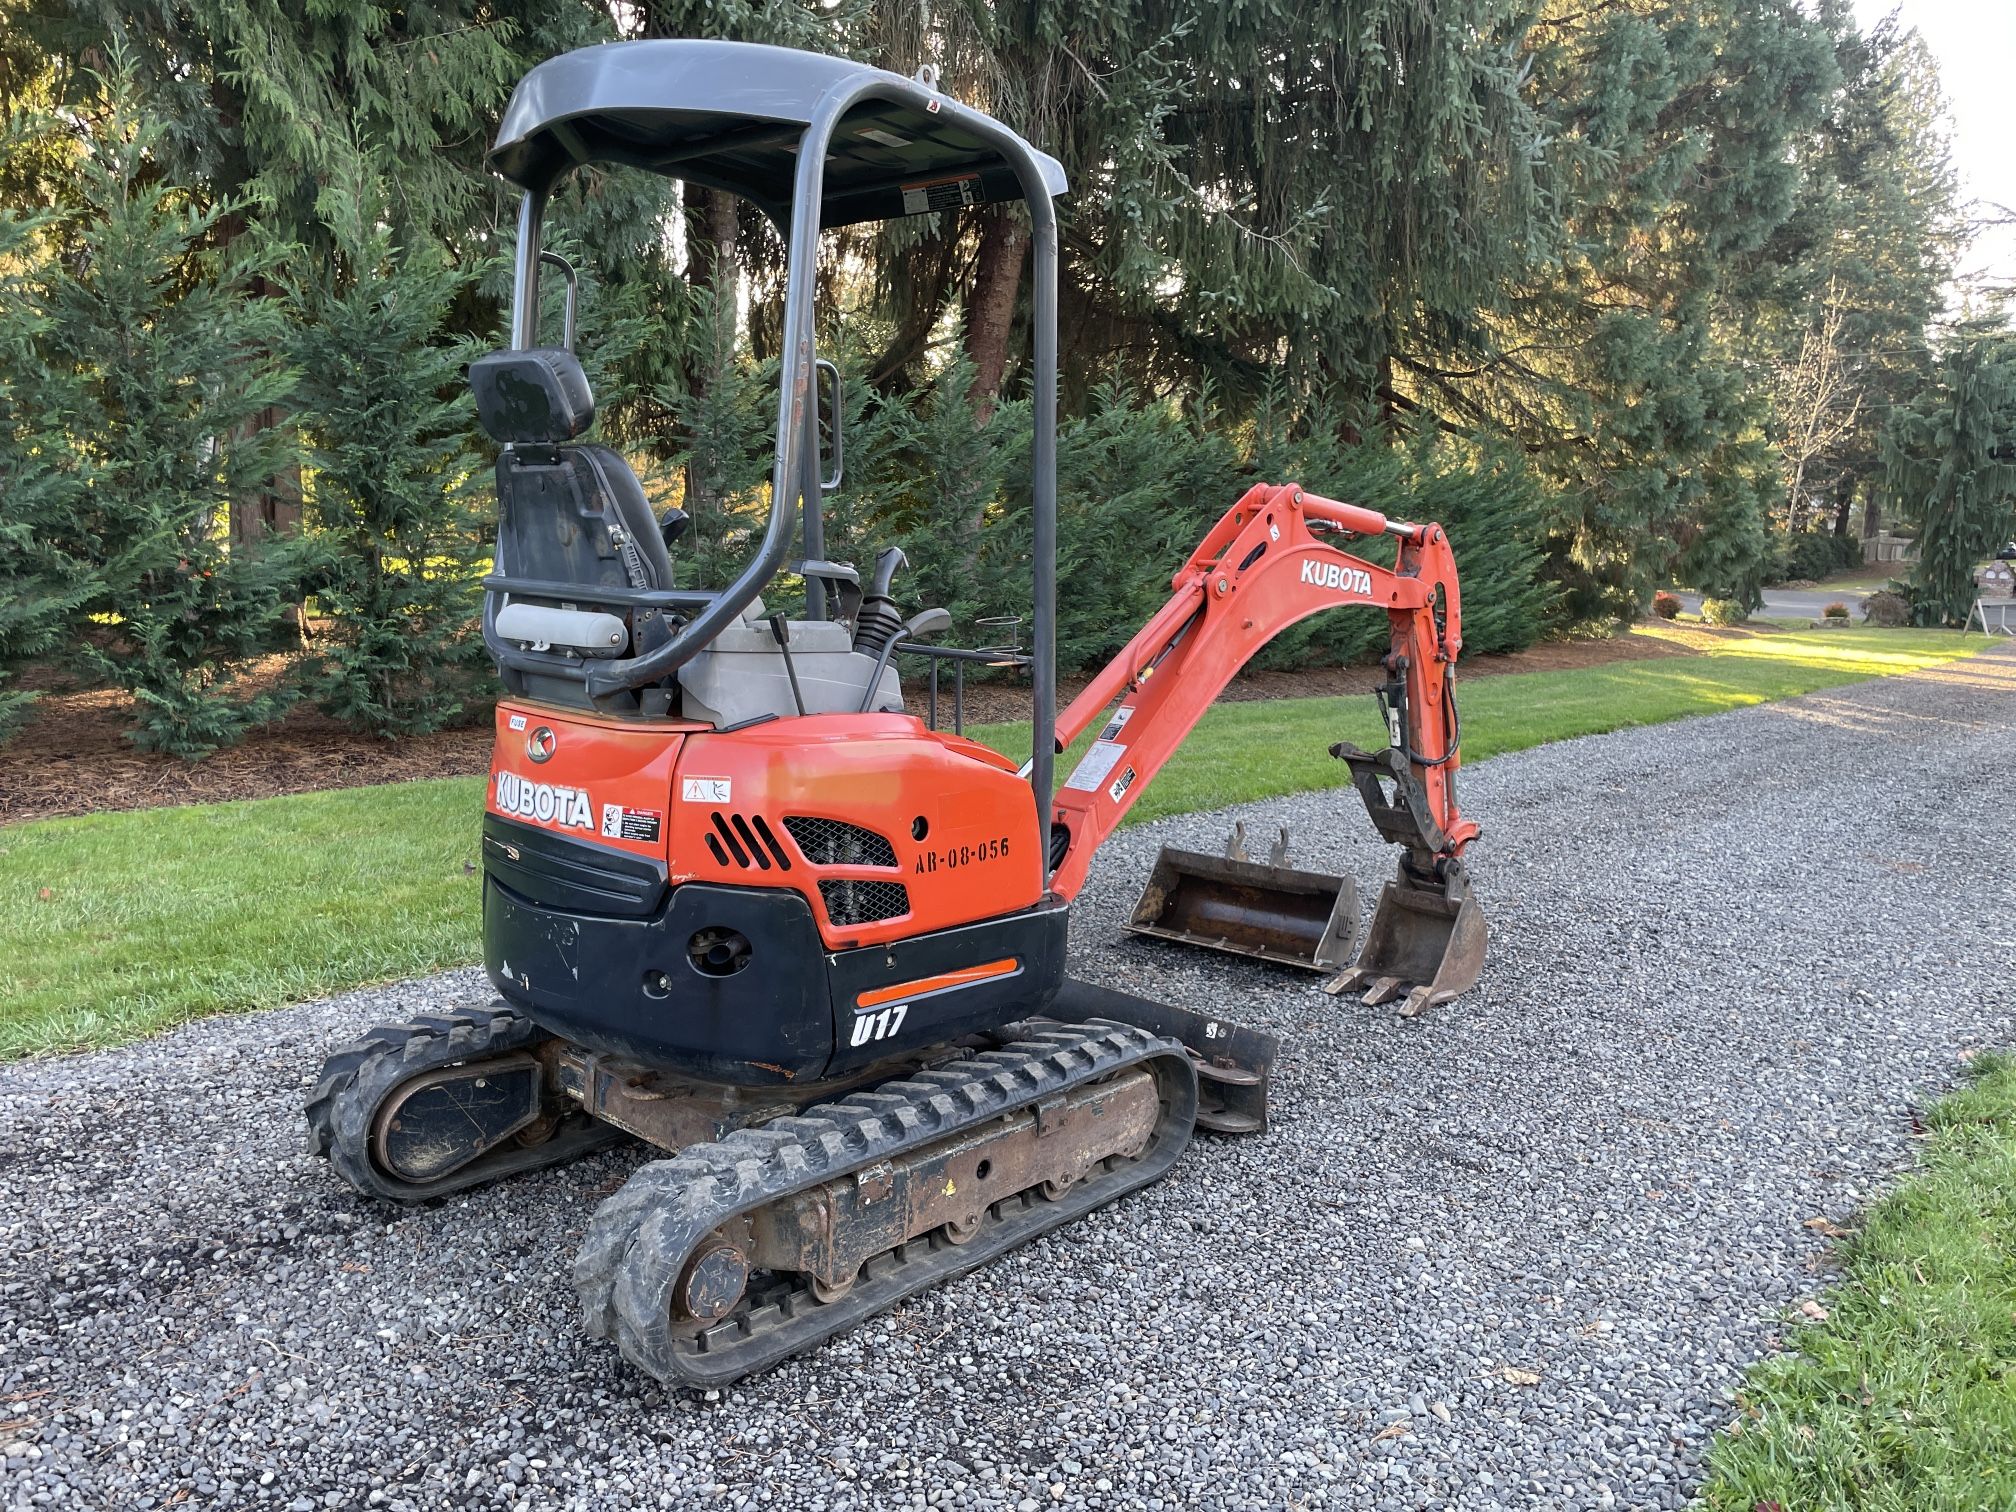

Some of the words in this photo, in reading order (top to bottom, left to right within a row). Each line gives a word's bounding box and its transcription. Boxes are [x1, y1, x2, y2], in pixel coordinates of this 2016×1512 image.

[1300, 559, 1372, 596] KUBOTA
[510, 718, 525, 728] FUSE
[496, 771, 595, 830] KUBOTA
[916, 837, 1009, 875] AR-08-056
[850, 1004, 909, 1047] U17
